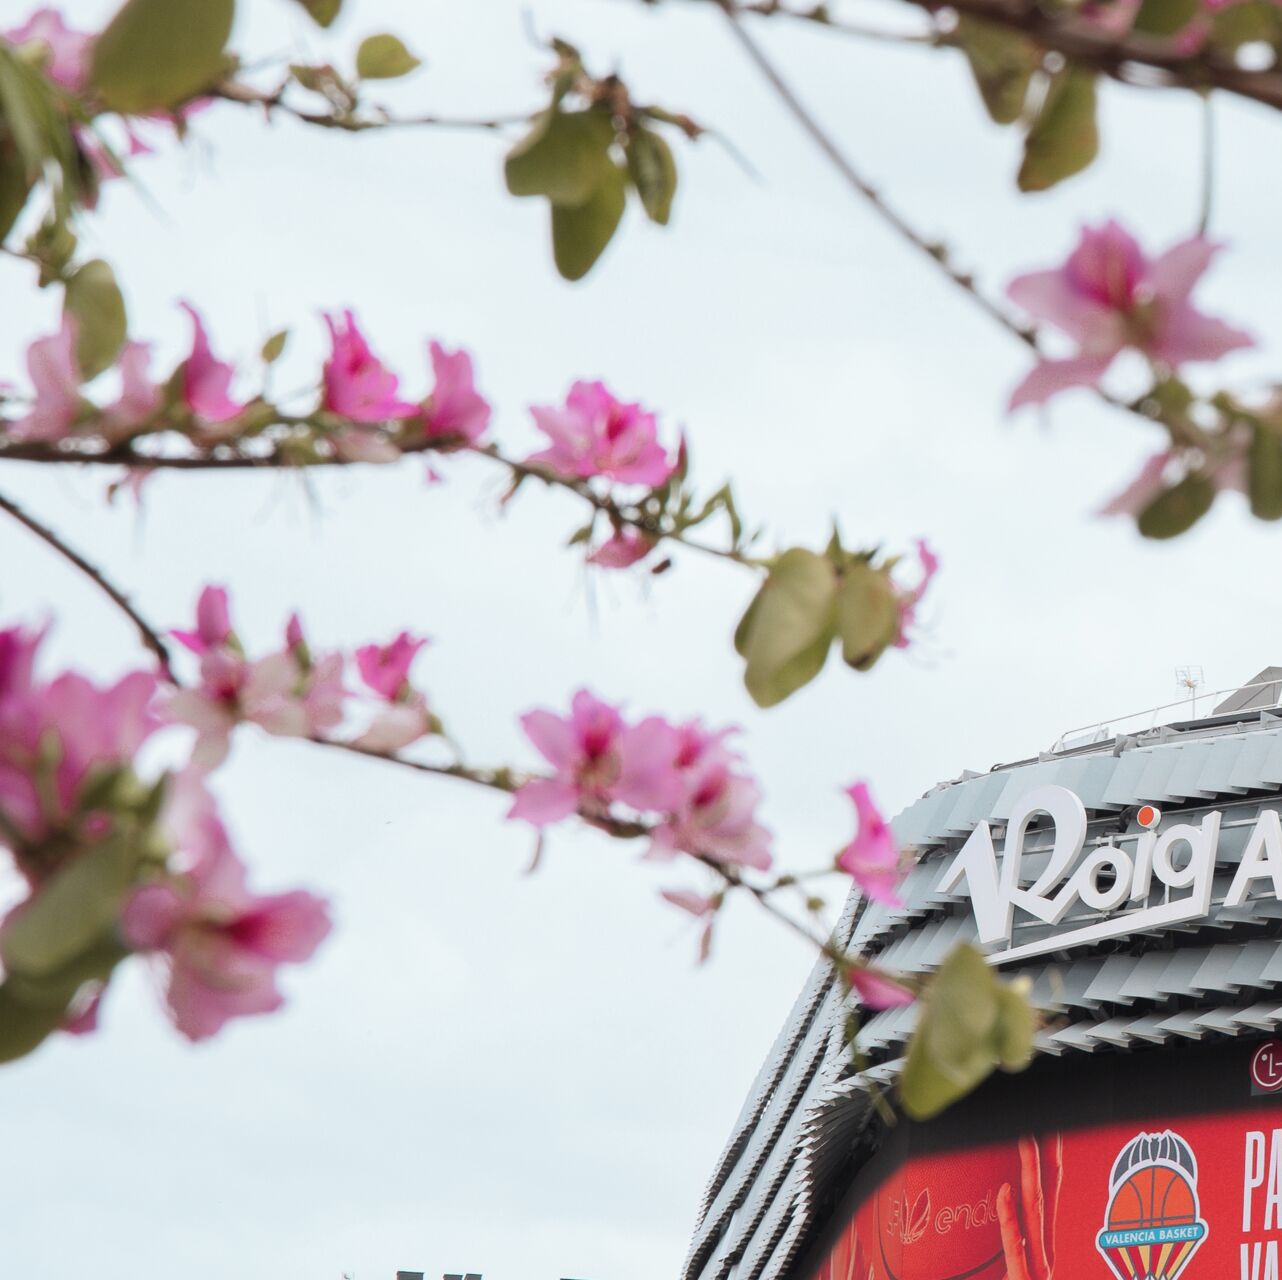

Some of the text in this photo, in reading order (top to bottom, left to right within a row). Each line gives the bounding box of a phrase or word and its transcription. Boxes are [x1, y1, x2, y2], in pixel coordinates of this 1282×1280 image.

[937, 785, 1222, 964] Roig
[1105, 1226, 1199, 1245] VALENCIA BASKET
